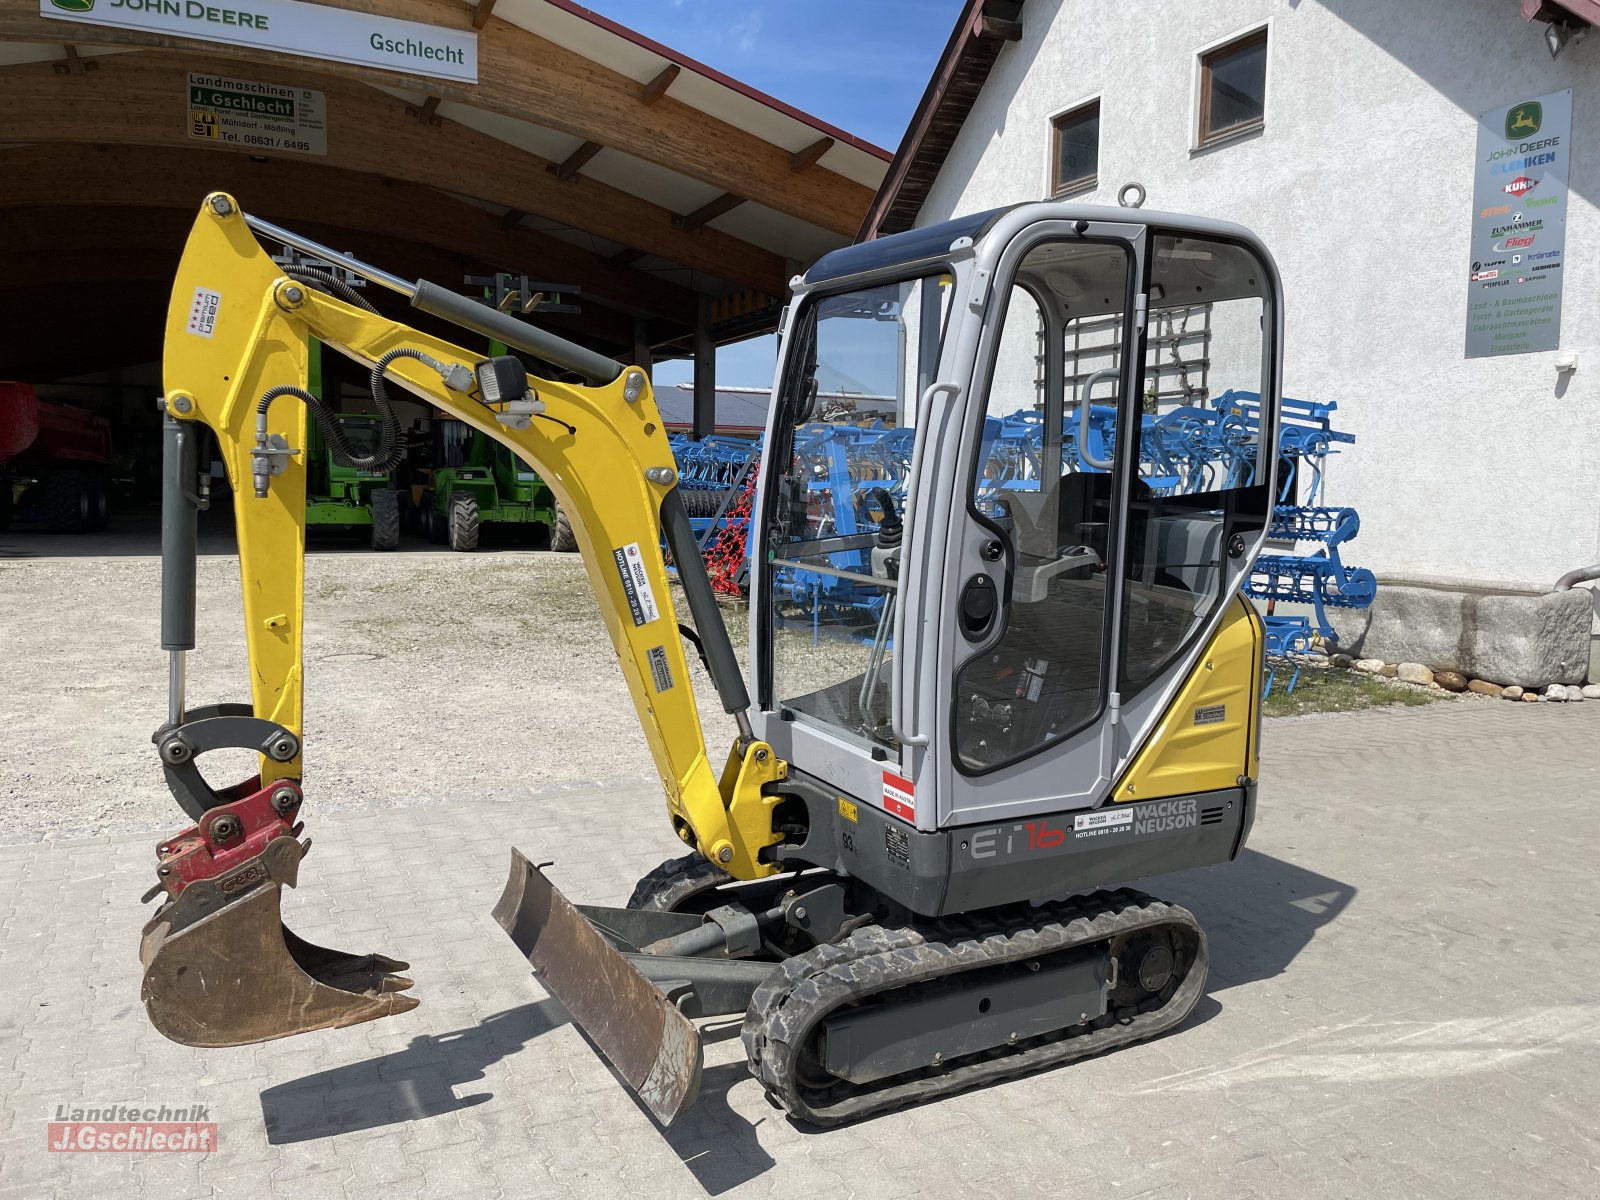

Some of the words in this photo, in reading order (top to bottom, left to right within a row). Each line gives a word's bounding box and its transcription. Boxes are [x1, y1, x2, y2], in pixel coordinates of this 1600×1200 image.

[186, 0, 269, 30] DEERE
[369, 32, 465, 65] Gschlecht
[190, 73, 295, 98] Landmaschinen
[195, 90, 207, 103] J.
[211, 93, 292, 115] Gschlecht
[221, 118, 258, 129] Mühldorf
[264, 123, 296, 135] Mößling
[221, 131, 241, 143] Tel.
[284, 139, 310, 151] 6495
[1486, 147, 1518, 162] JOHN
[1519, 137, 1560, 154] DEERE
[1504, 179, 1535, 193] KUHN
[1491, 219, 1542, 235] ZUNHAMMER
[1505, 233, 1536, 248] Fliegl
[1502, 292, 1559, 306] Baumaschinen
[1473, 318, 1552, 333] Gebrauchtmaschinen
[615, 550, 628, 579] HOTLINE
[1134, 799, 1198, 820] WACKER
[1134, 812, 1198, 835] NEUSON
[842, 832, 853, 851] 93
[1075, 830, 1097, 839] HOTLINE
